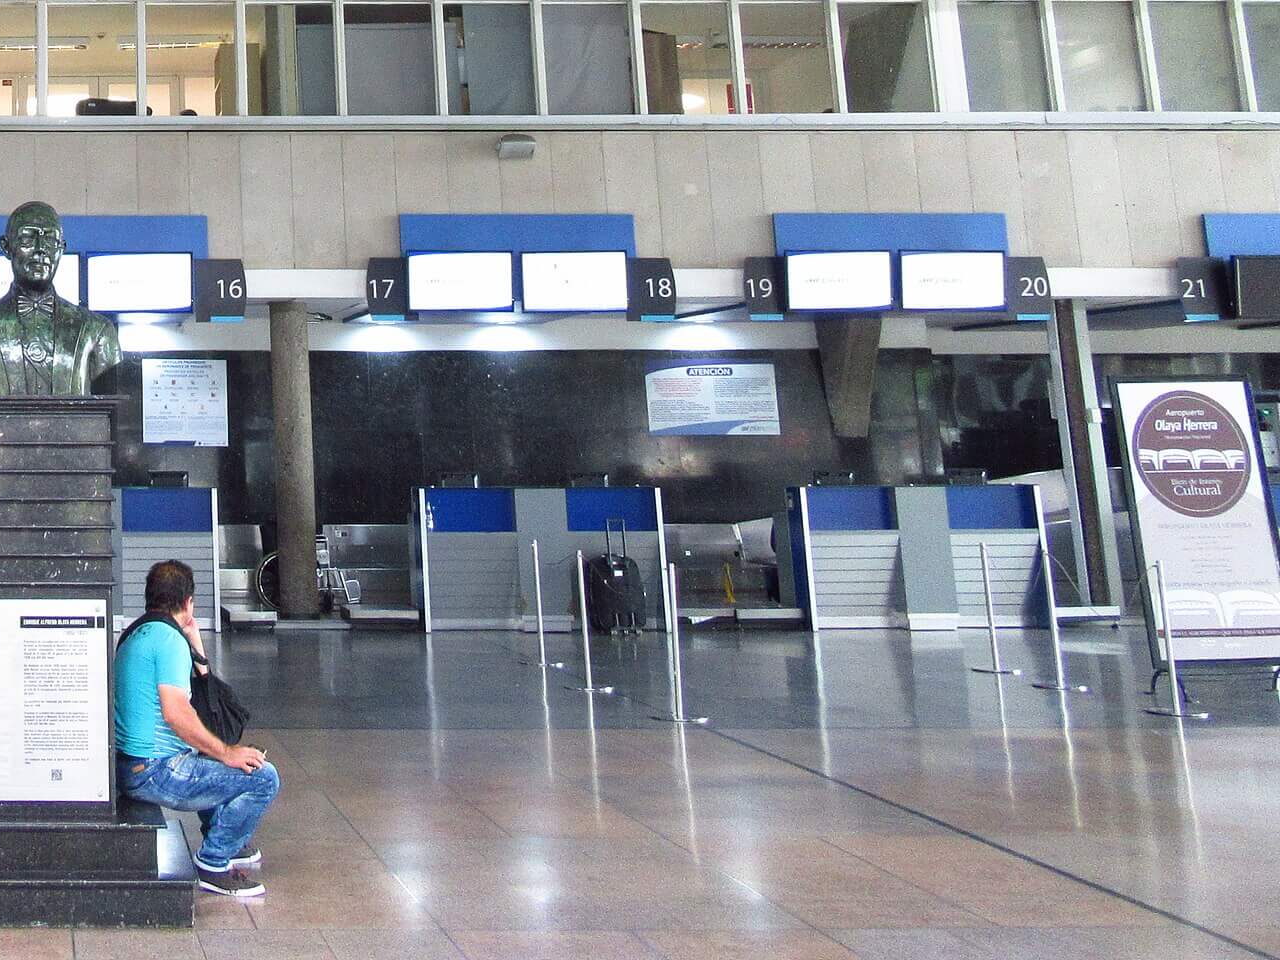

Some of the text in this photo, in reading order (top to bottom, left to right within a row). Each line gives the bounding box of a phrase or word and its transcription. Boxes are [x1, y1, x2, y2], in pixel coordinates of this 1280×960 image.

[216, 279, 242, 299] 16
[369, 279, 394, 299] 17
[645, 278, 672, 298] 18
[746, 278, 773, 298] 19
[1020, 277, 1048, 297] 20
[1181, 278, 1206, 298] 21
[1165, 409, 1205, 417] Aeropuerto
[1154, 417, 1218, 432] Olaya Herrera
[1173, 483, 1221, 496] Cultural
